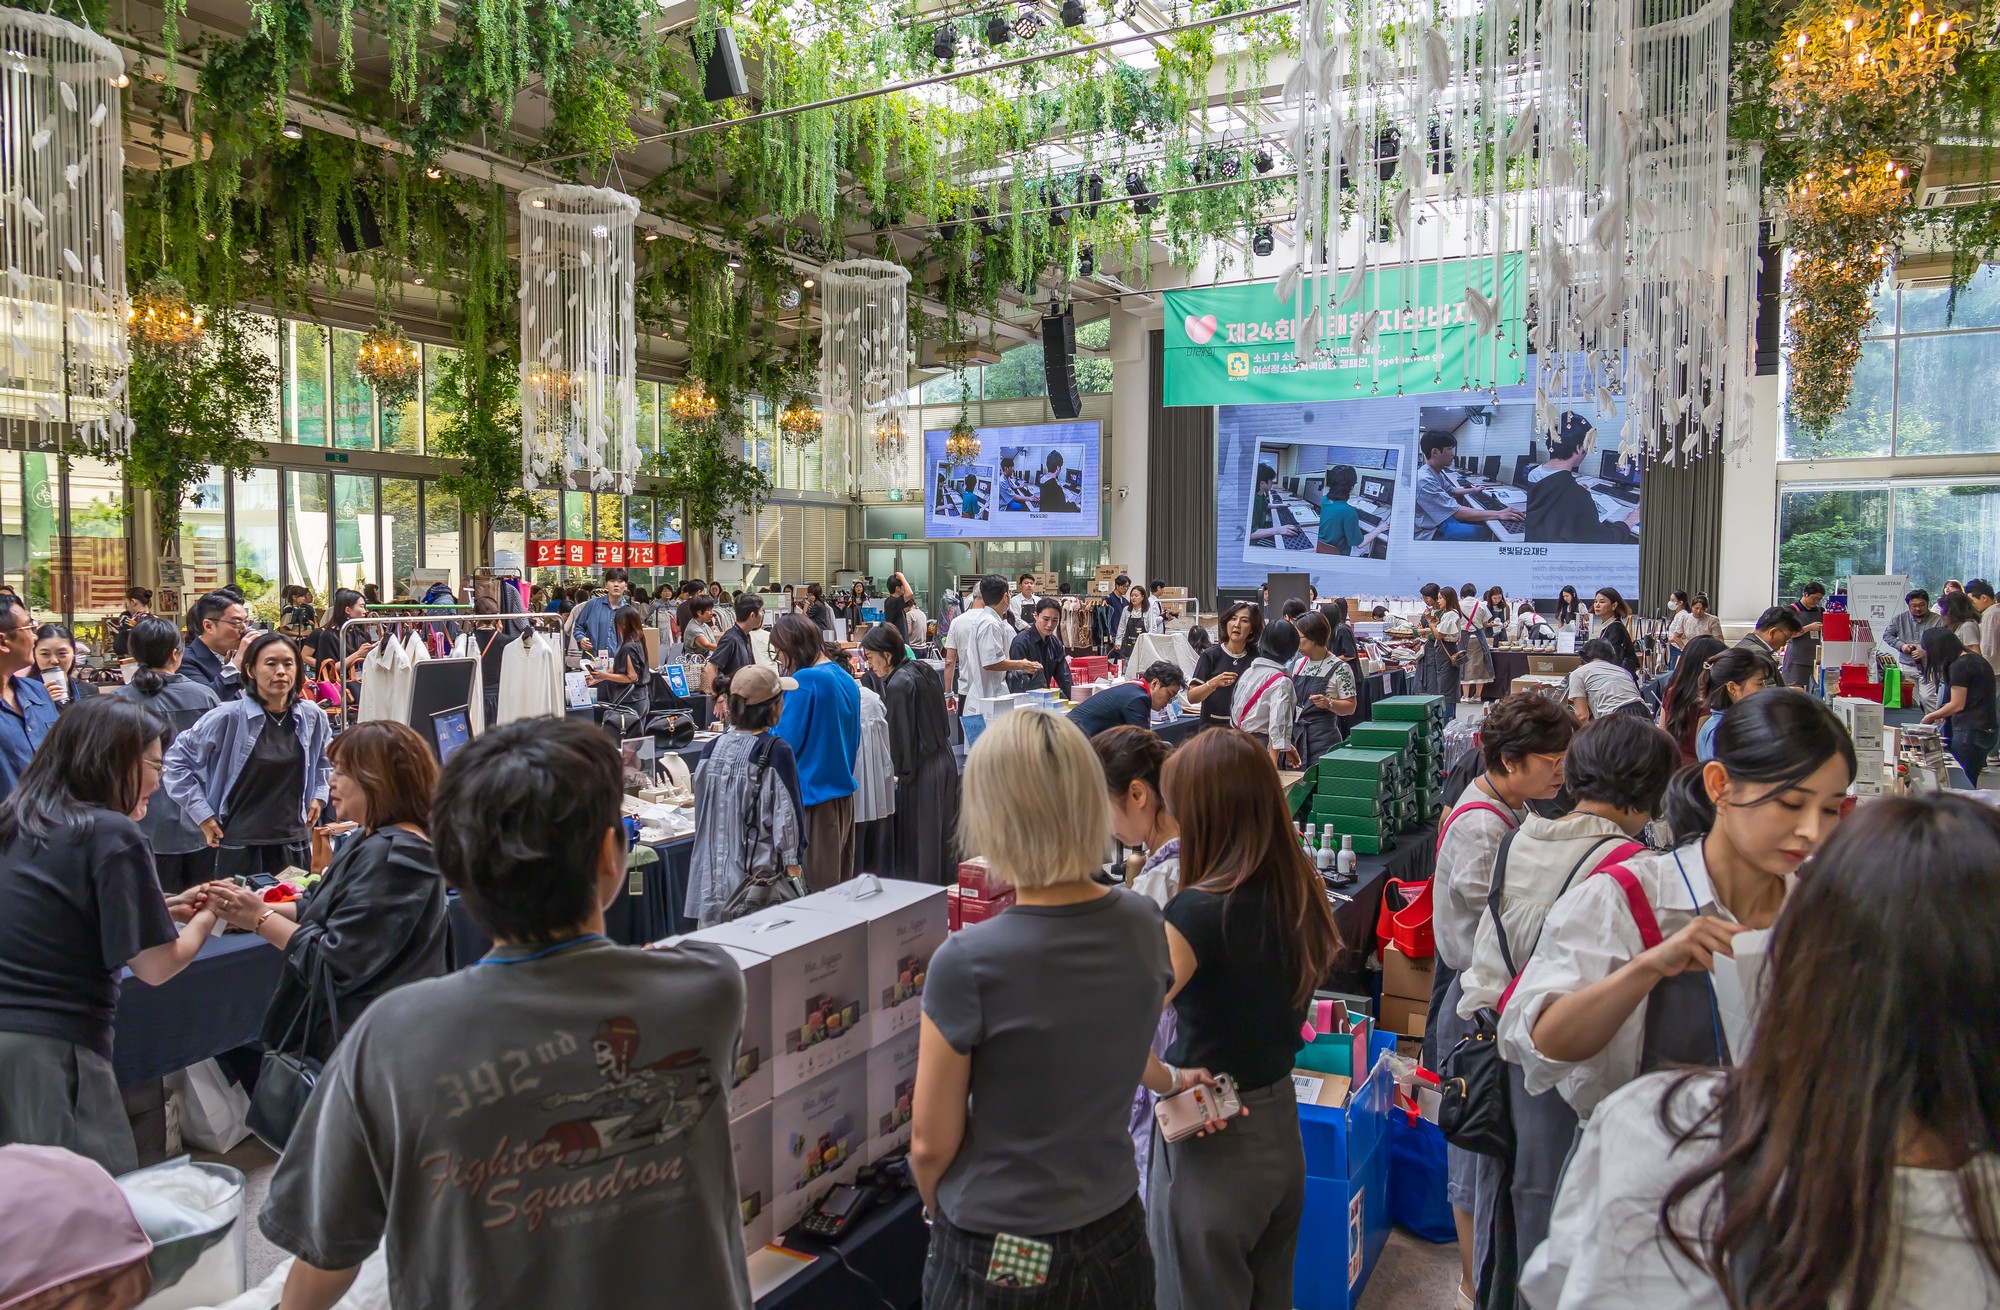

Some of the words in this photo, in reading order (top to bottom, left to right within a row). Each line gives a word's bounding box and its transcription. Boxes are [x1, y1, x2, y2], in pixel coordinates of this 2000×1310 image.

[1225, 318, 1296, 343] 제24회
[1253, 352, 1280, 363] 소녀가
[537, 544, 583, 563] 오브엠
[594, 545, 654, 563] 균일가전
[1499, 546, 1548, 556] 햇빛담요재단
[437, 1029, 577, 1119] 392nd
[420, 1136, 564, 1199] Fighter
[483, 1156, 685, 1232] Squadron
